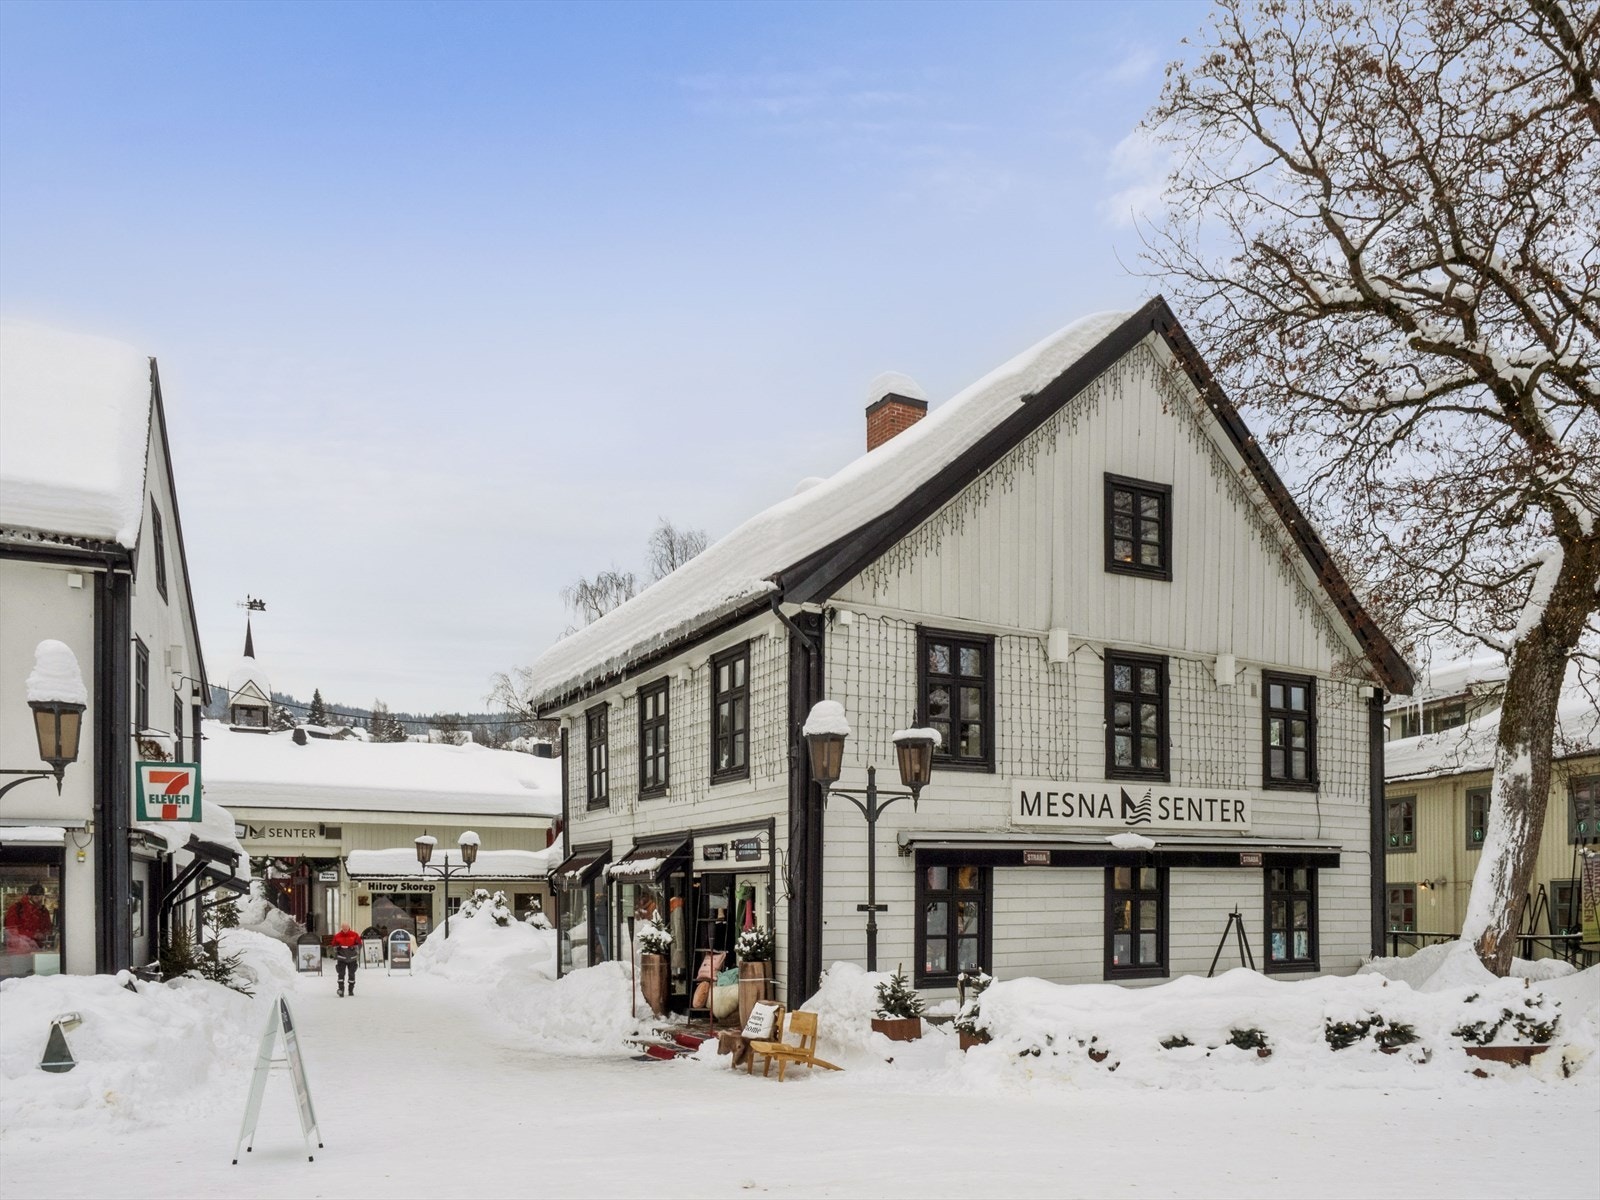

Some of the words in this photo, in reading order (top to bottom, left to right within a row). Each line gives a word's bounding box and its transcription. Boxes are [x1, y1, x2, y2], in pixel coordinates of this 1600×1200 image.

[149, 770, 189, 819] 7
[1020, 790, 1114, 819] MESNA
[1158, 796, 1246, 823] SENTER
[268, 827, 316, 839] SENTER
[368, 882, 398, 892] Hilroy
[401, 882, 436, 892] Skorep
[1583, 861, 1594, 922] TERRASSEN
